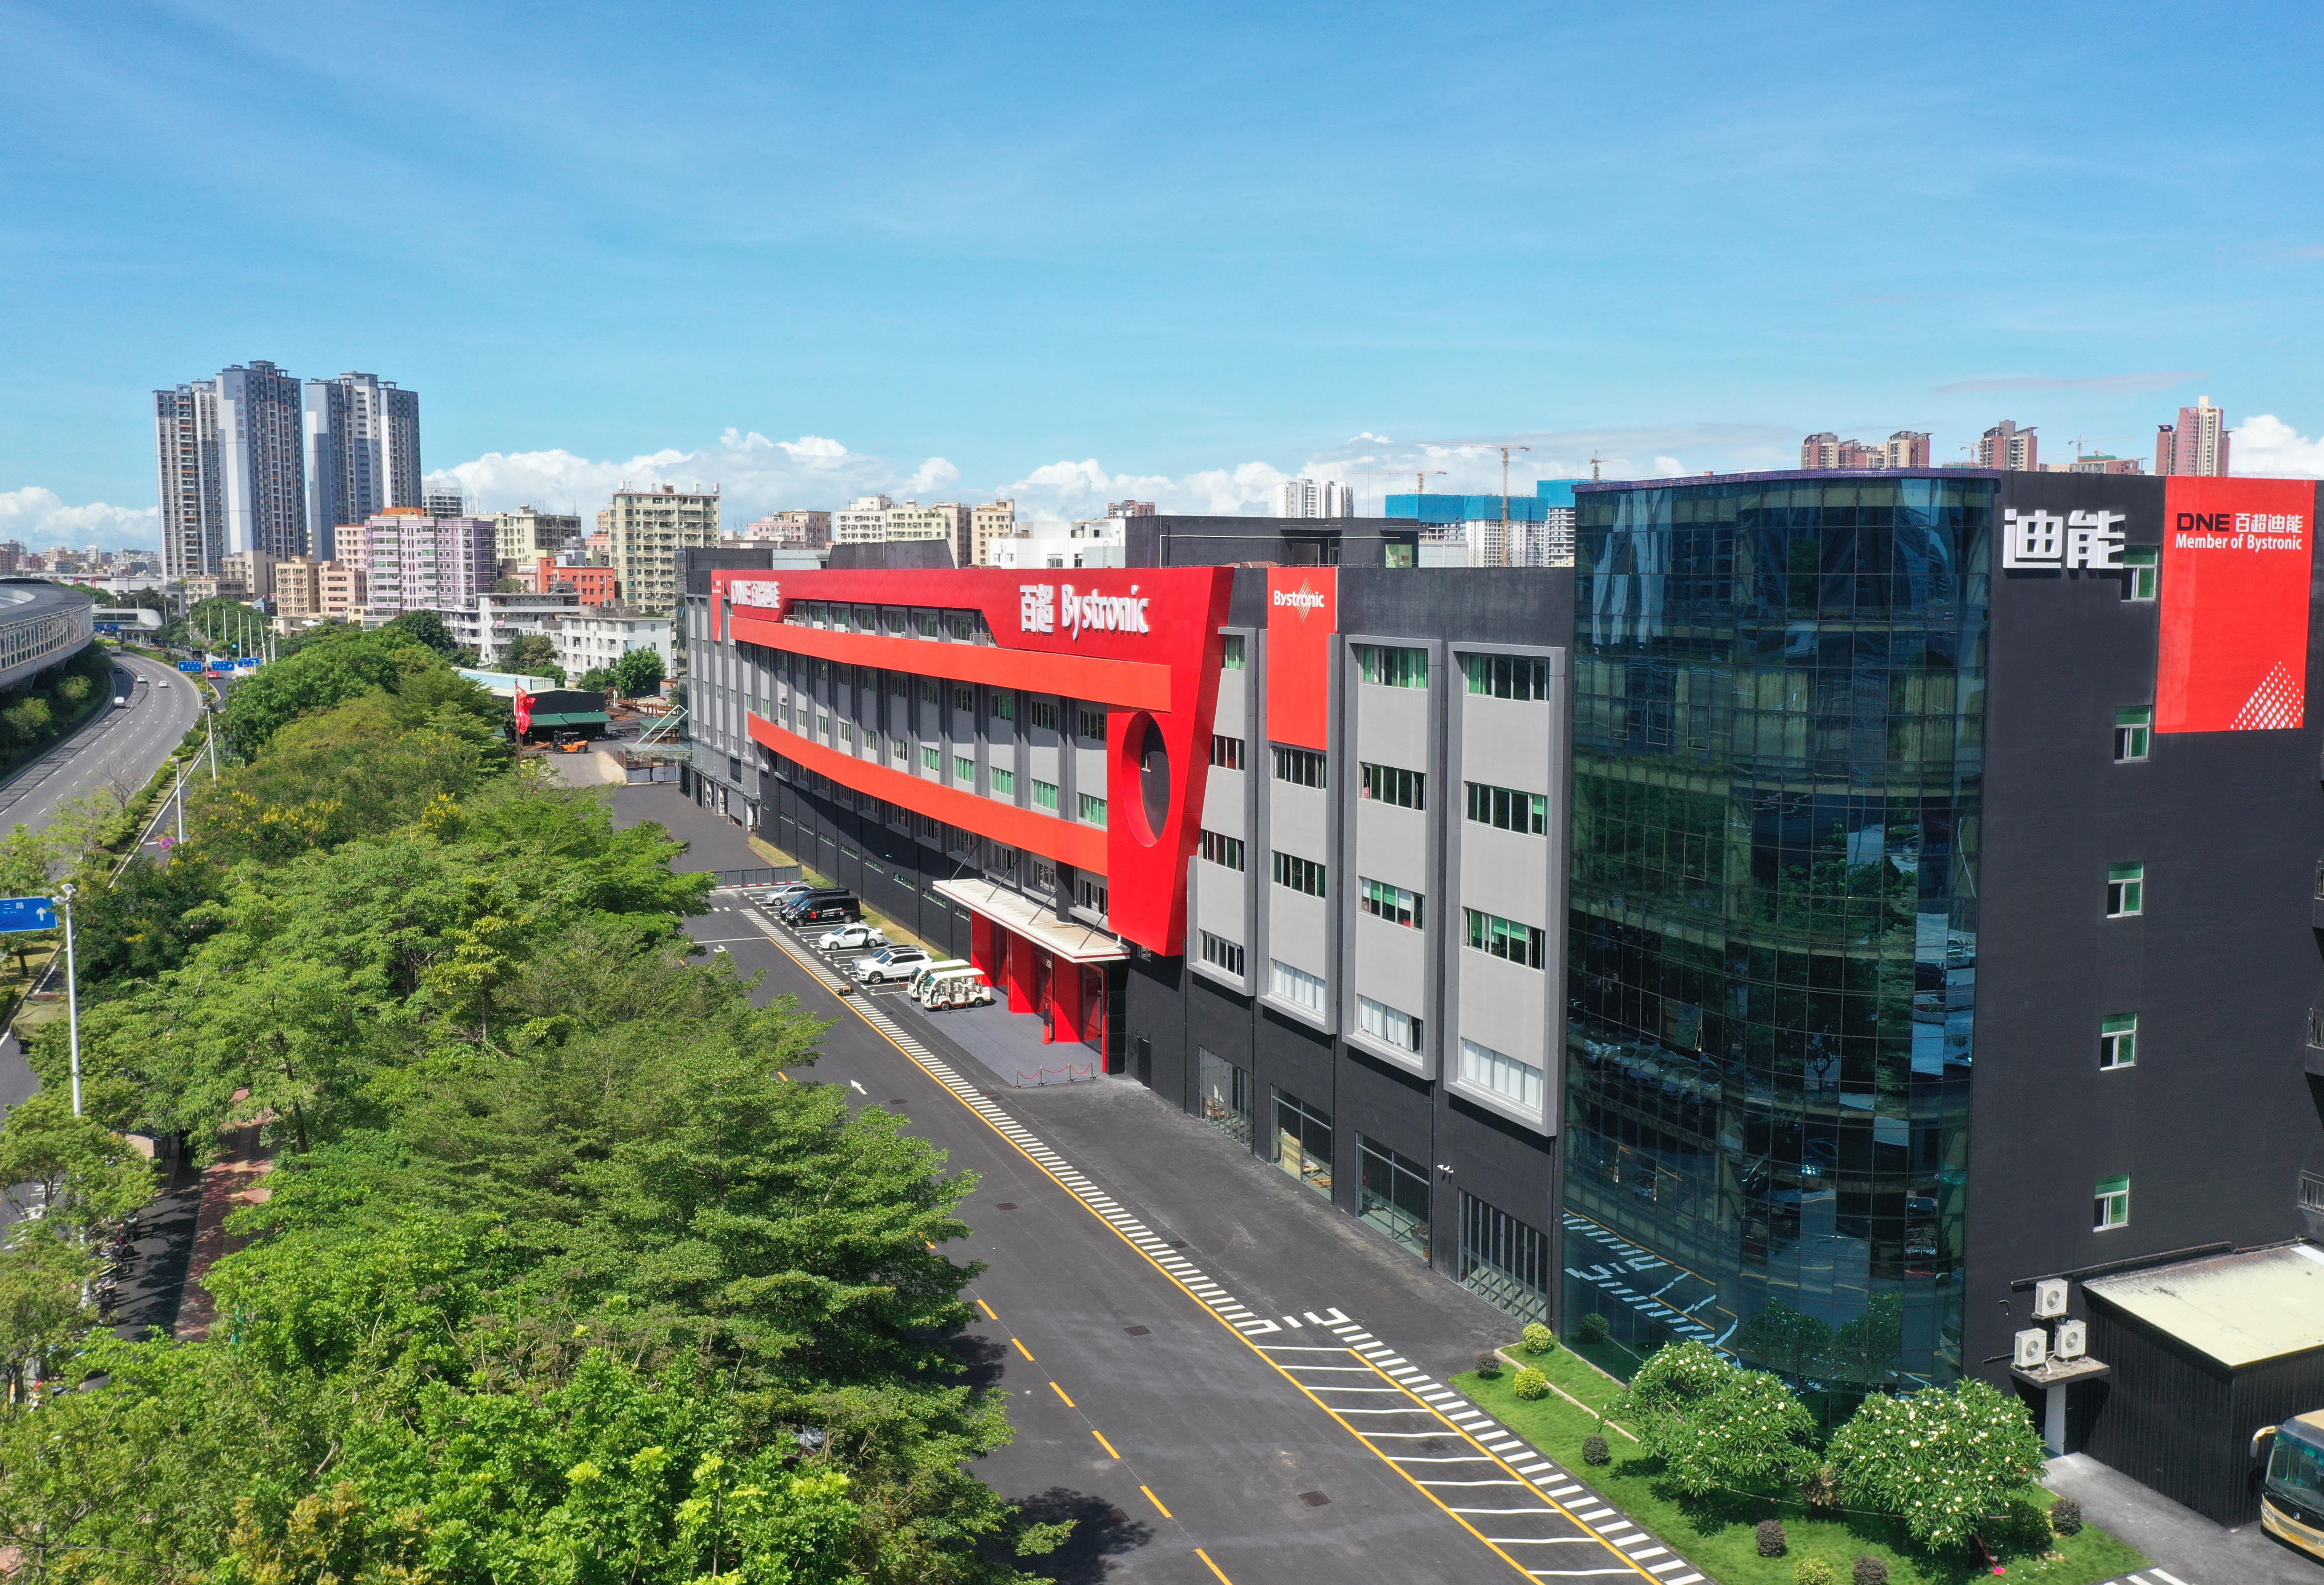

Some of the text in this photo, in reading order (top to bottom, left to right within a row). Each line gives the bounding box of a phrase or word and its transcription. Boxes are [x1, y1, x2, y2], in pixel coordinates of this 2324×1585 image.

[2177, 513, 2303, 533] DNE 百超迪能
[2003, 509, 2125, 568] 迪能
[2176, 533, 2302, 553] Member of Bystronic
[731, 581, 751, 605] DNE
[1274, 590, 1324, 608] Bystronic
[1020, 583, 1150, 640] 百超 Bystronic
